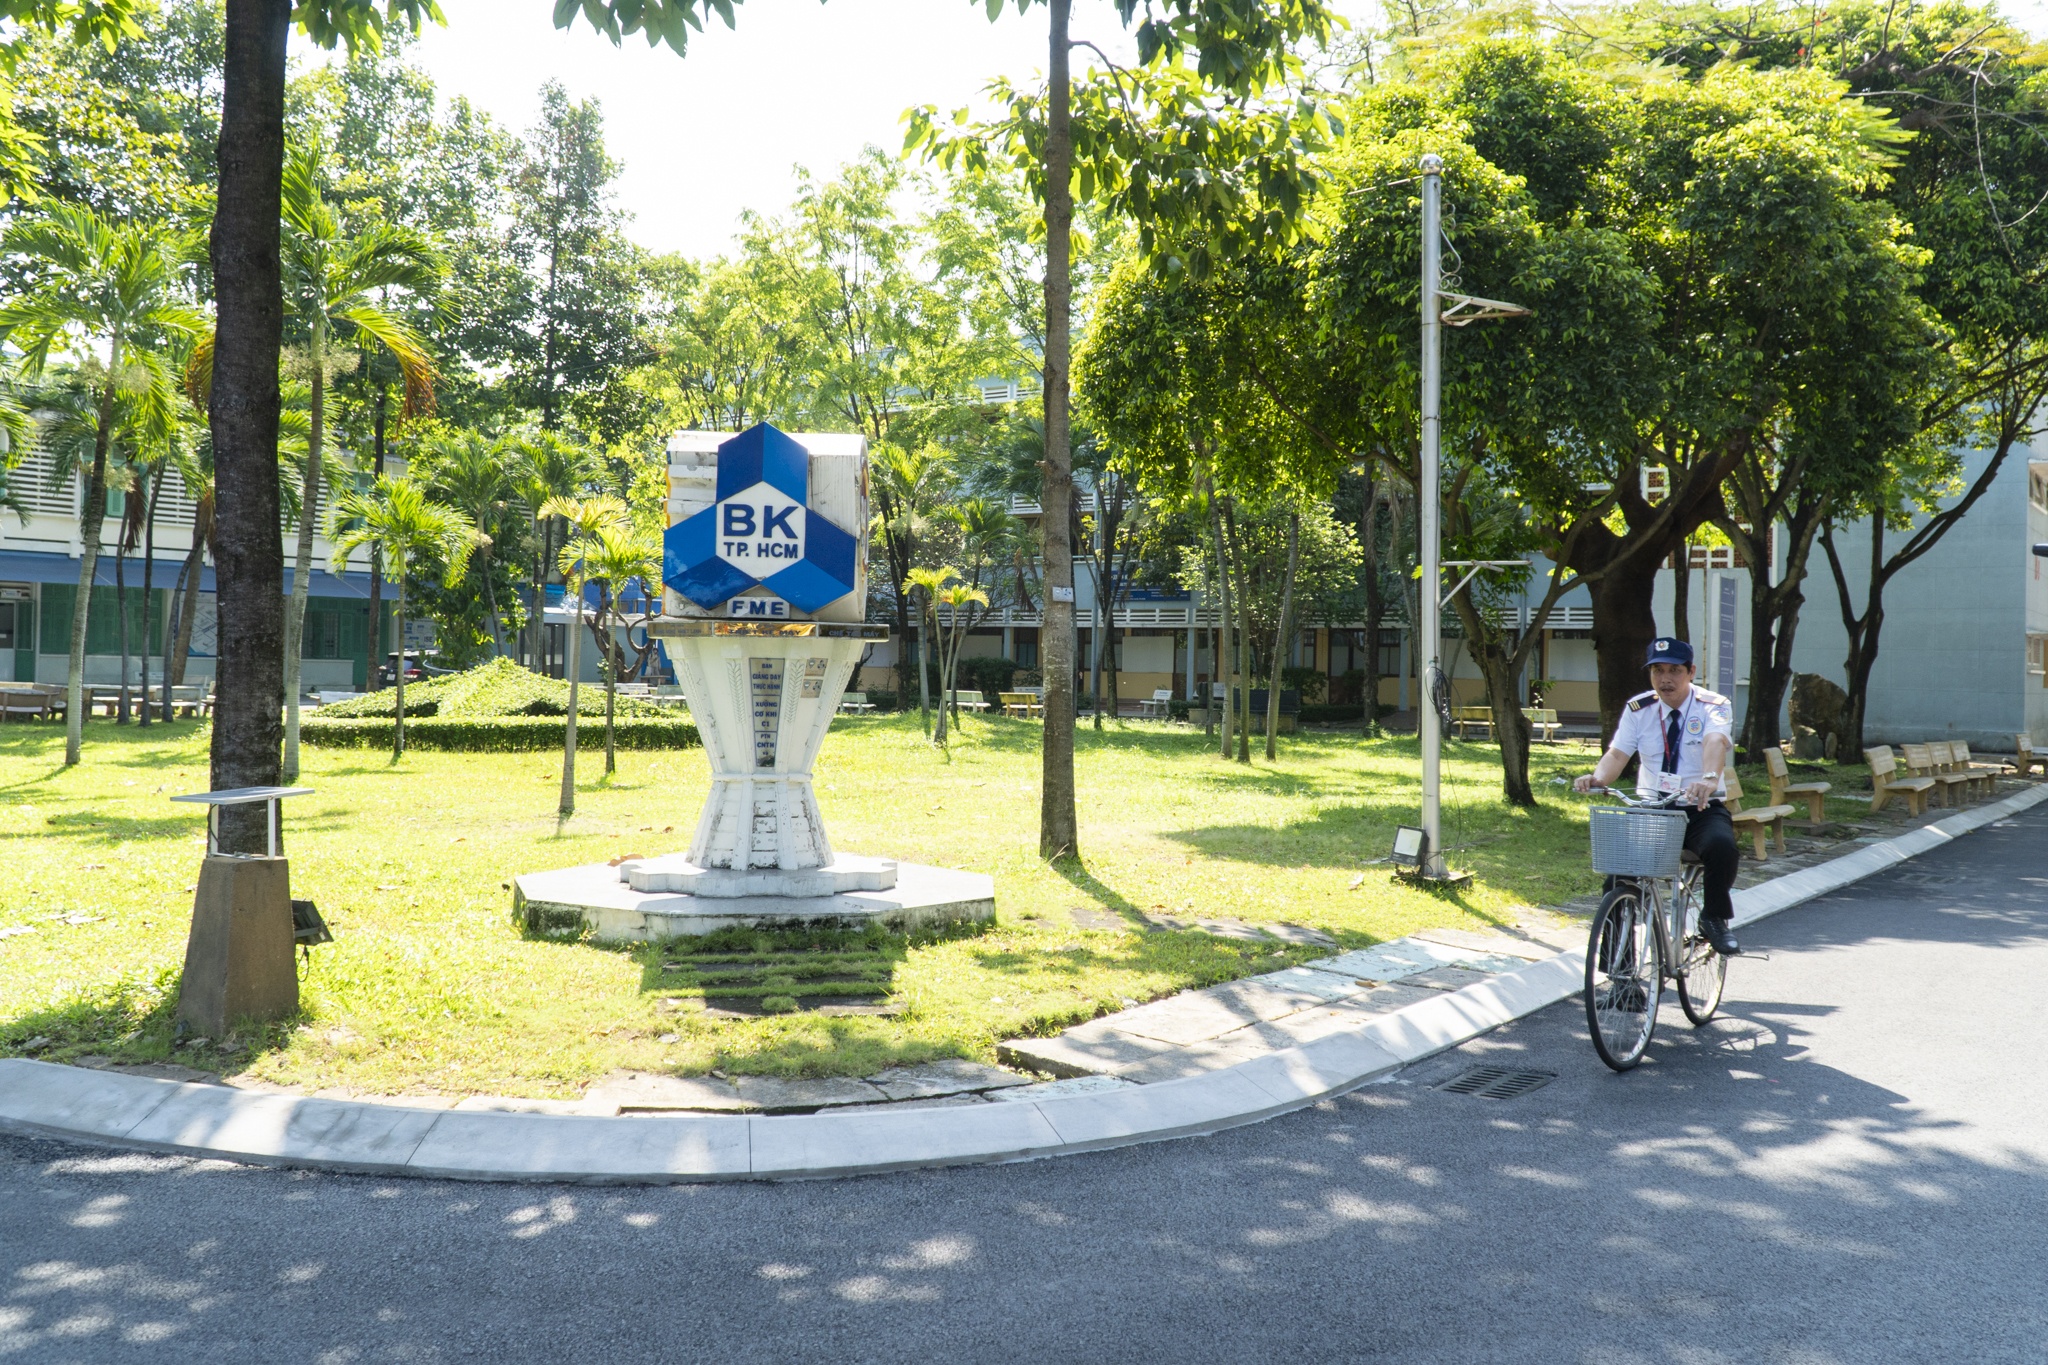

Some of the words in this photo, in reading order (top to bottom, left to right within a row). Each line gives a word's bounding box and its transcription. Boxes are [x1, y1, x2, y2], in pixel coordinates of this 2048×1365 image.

[723, 503, 799, 540] BK
[723, 541, 750, 557] TP.
[757, 542, 799, 559] HCM
[732, 600, 784, 616] FME
[752, 672, 768, 680] GIẢNG
